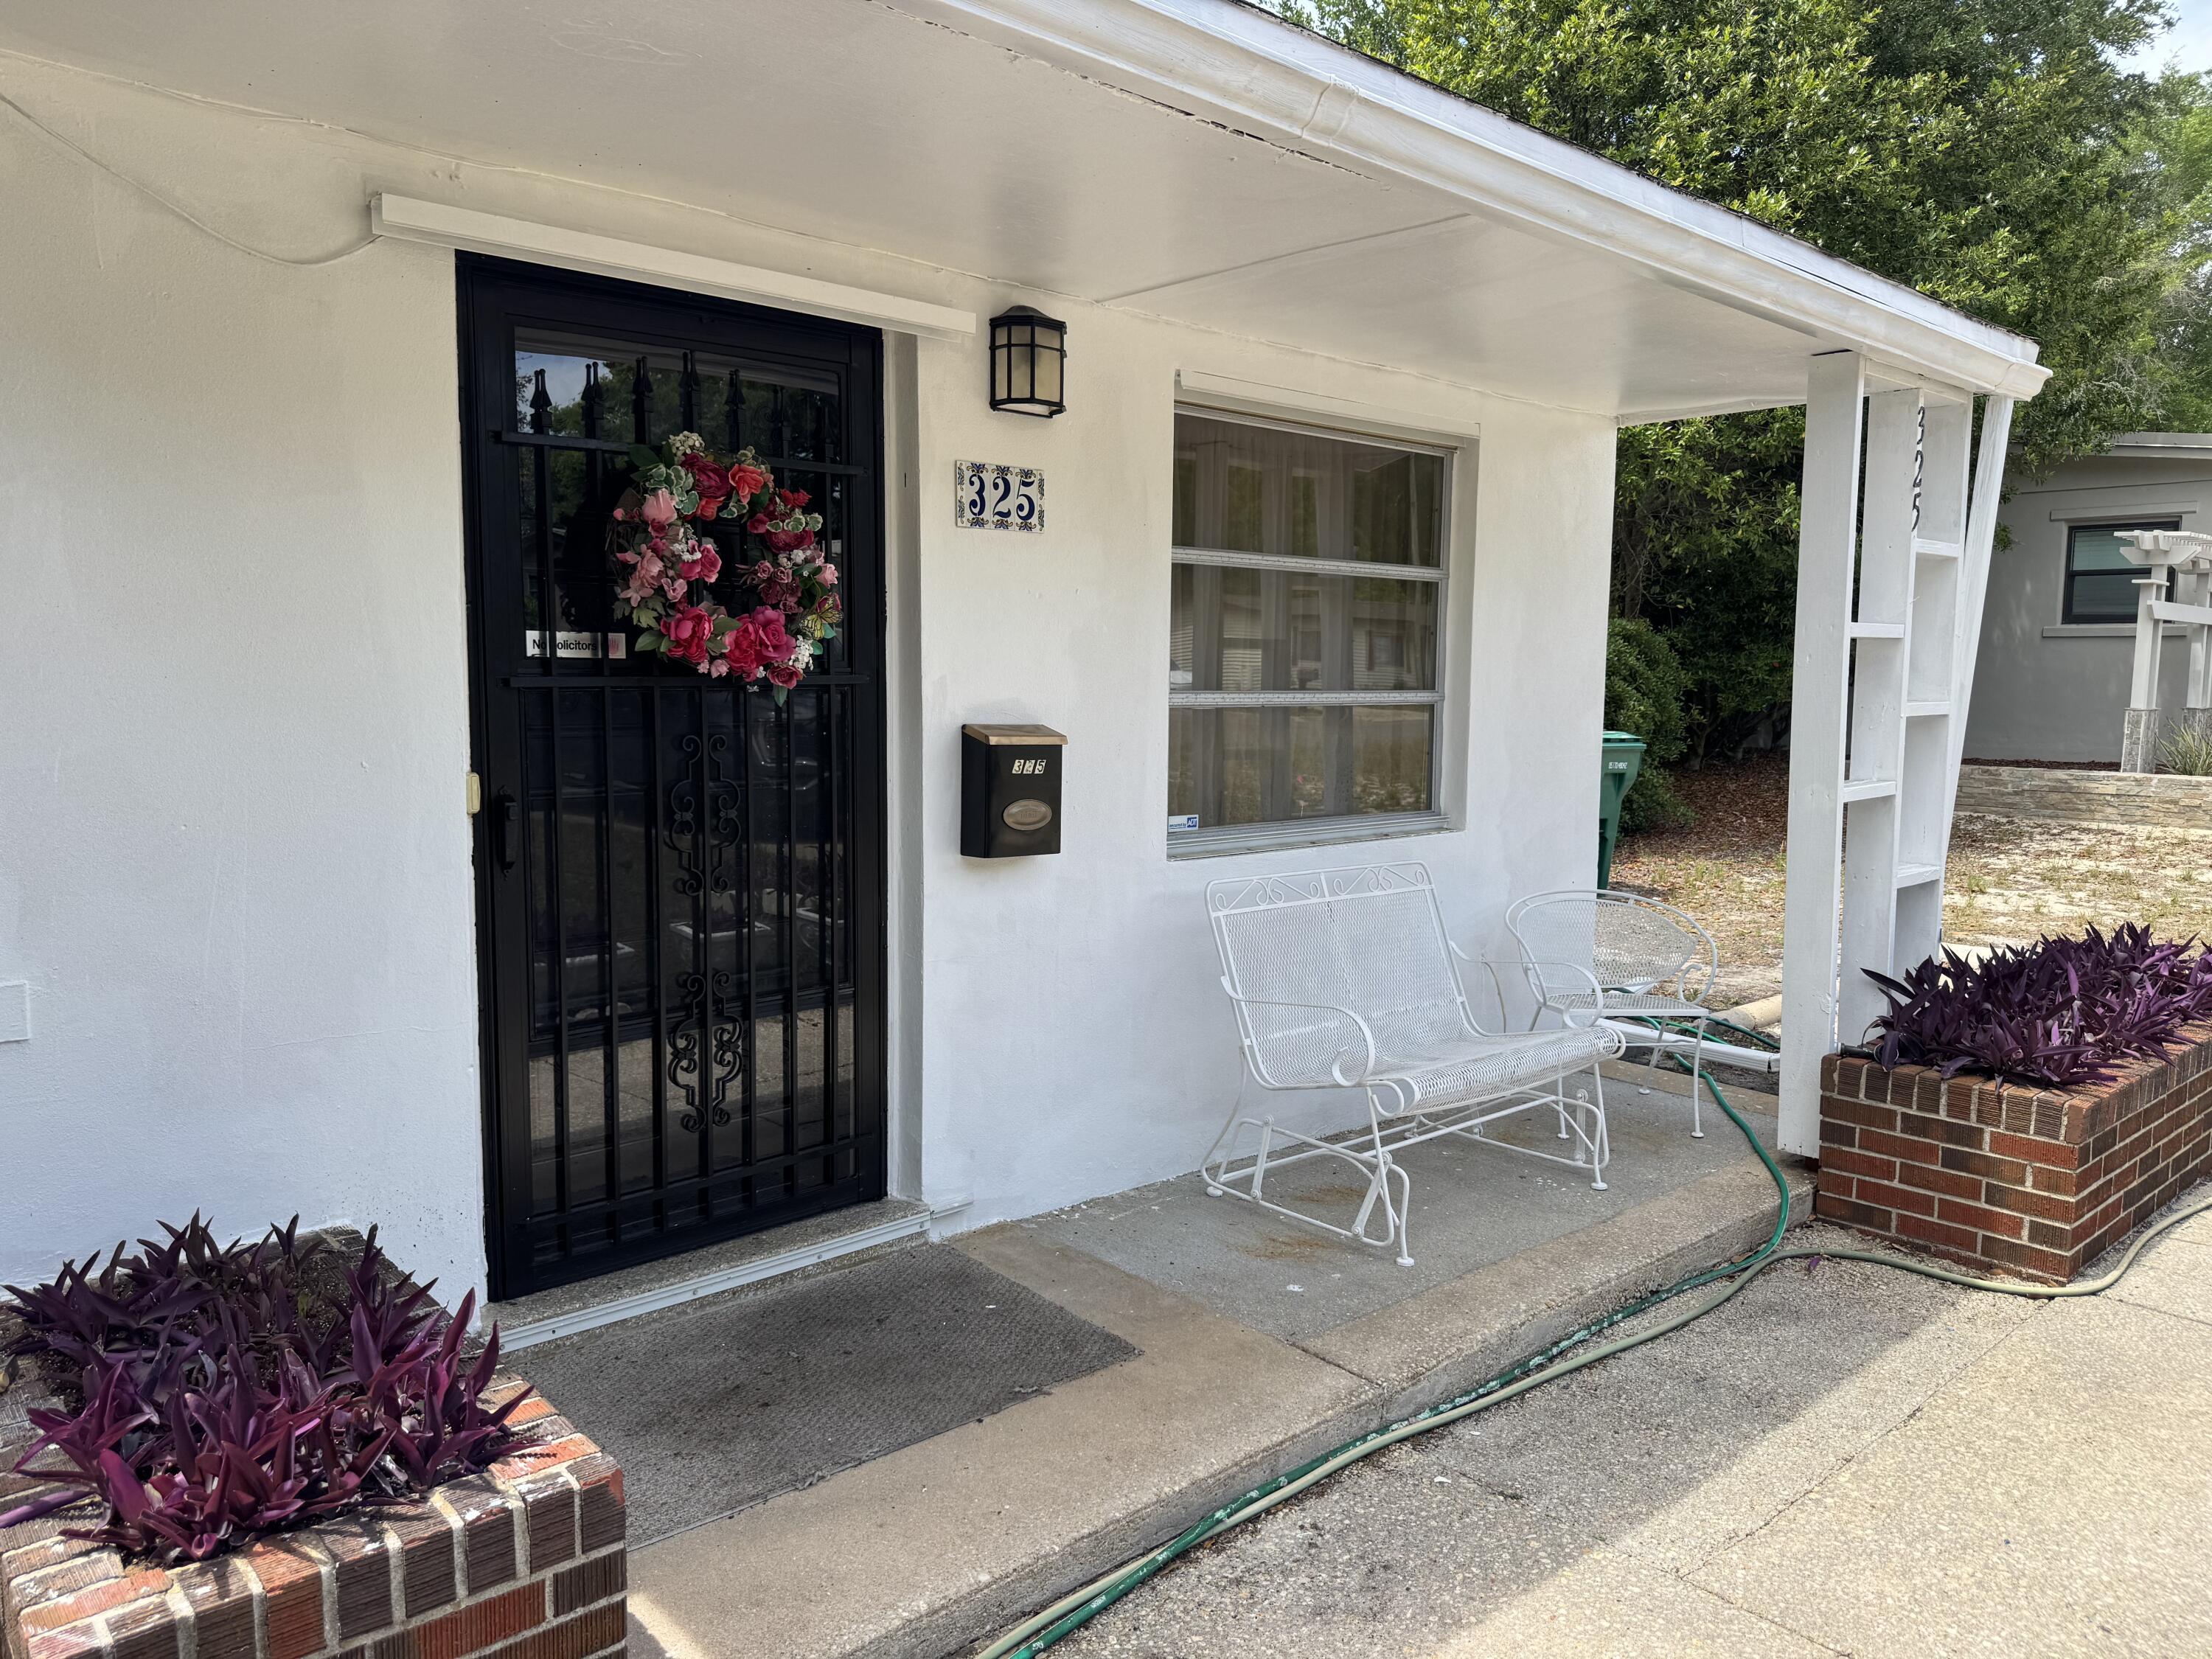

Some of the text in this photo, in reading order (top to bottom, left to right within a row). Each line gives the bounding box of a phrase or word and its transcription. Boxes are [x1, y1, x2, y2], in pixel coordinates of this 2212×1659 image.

[1911, 406, 1925, 532] 325
[969, 473, 1035, 521] 325
[532, 639, 597, 651] No olicitors
[1014, 760, 1046, 773] 325
[1187, 818, 1197, 827] ADT
